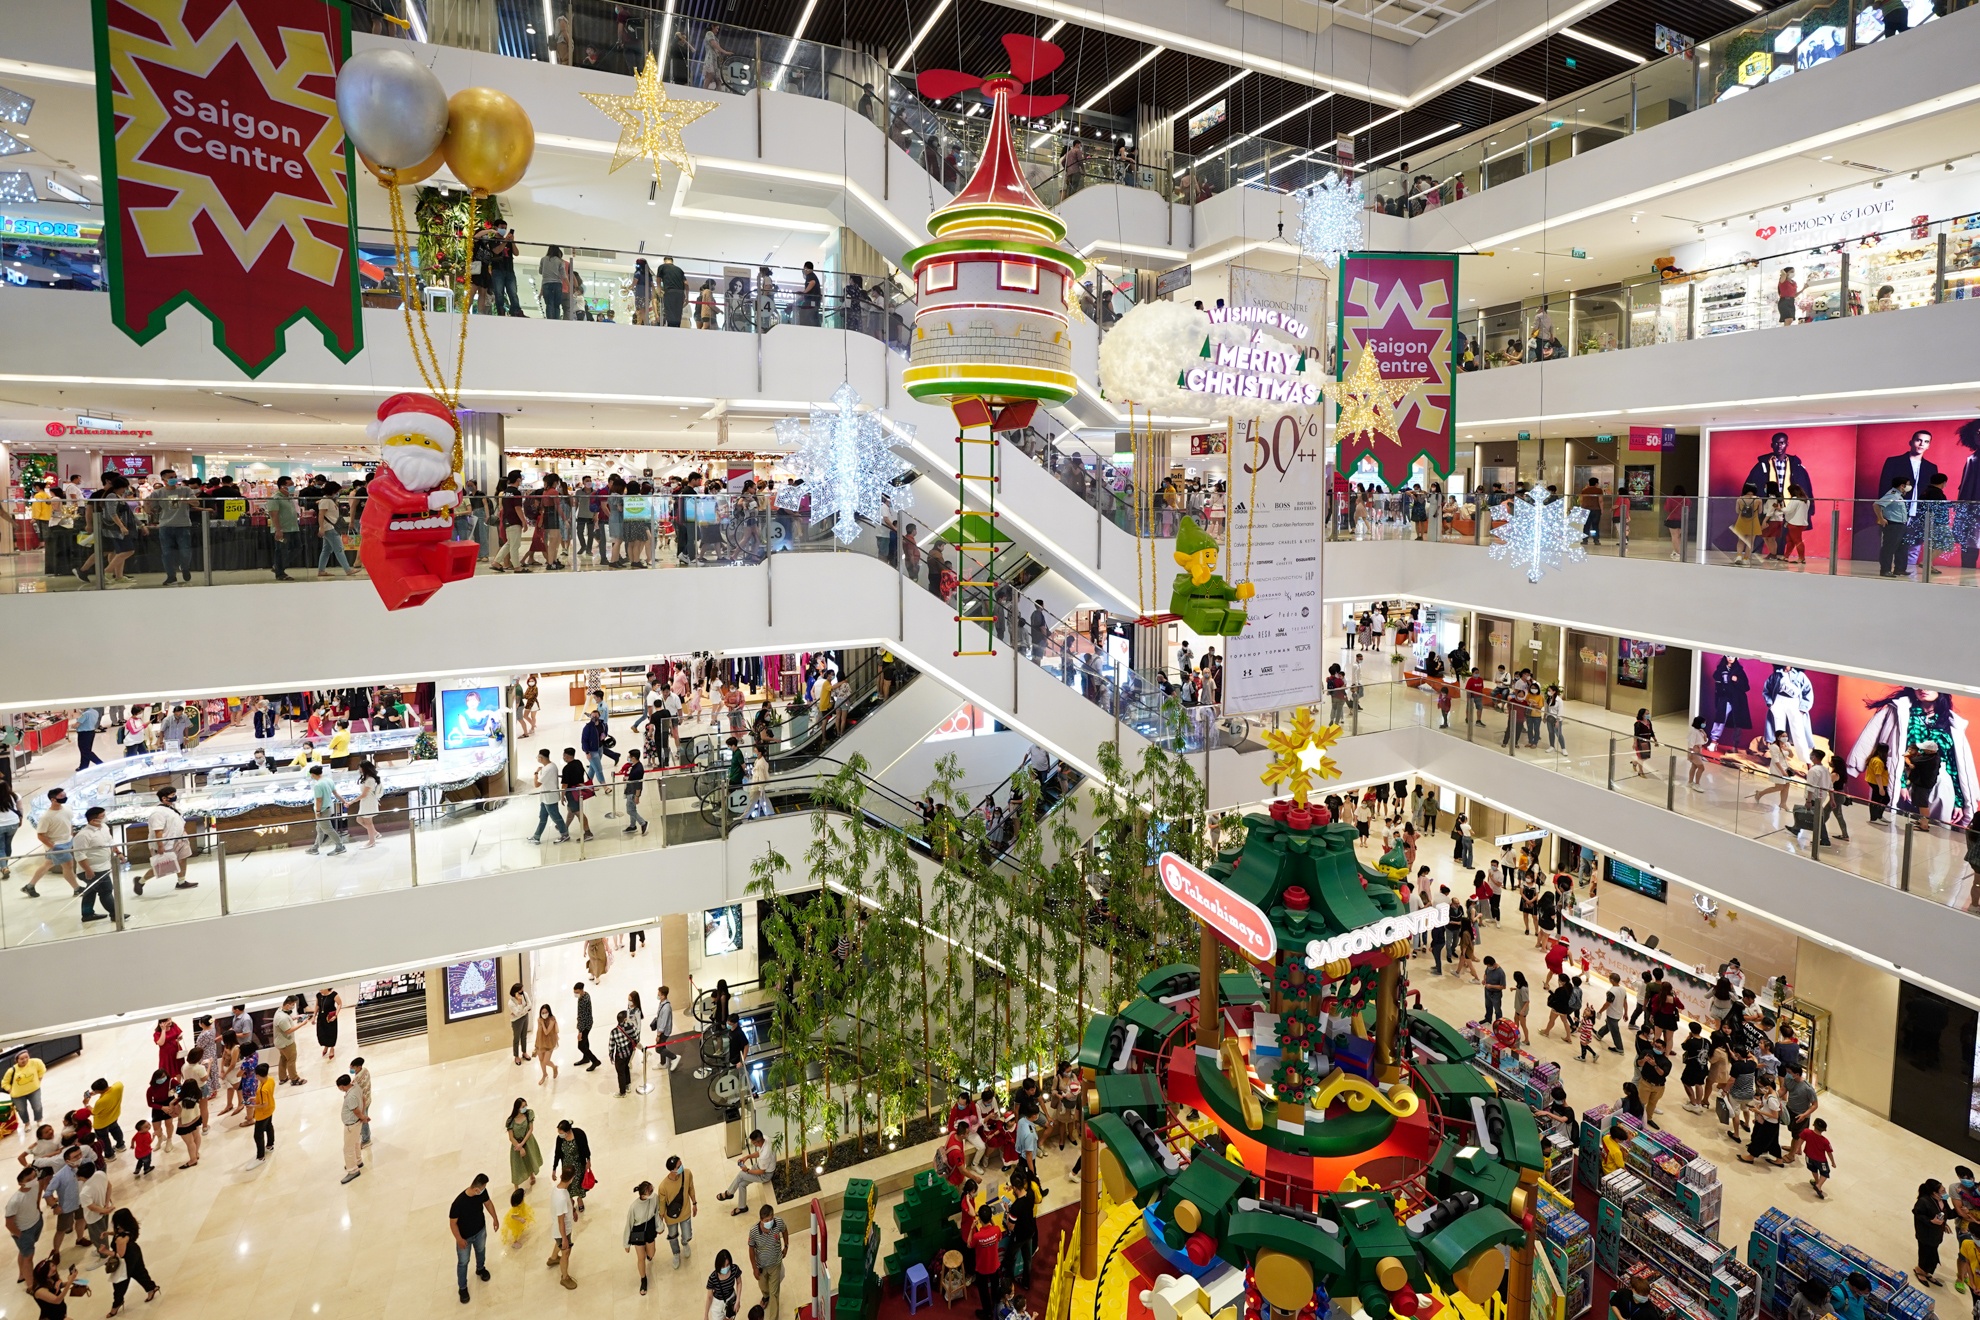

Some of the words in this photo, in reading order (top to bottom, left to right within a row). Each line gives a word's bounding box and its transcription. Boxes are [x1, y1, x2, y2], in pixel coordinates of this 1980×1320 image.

[730, 66, 747, 80] L5
[173, 89, 300, 148] Saigon
[173, 126, 303, 179] Centre
[1142, 172, 1154, 183] L5
[1779, 213, 1836, 236] MEMORY
[1840, 210, 1853, 222] &
[1857, 199, 1895, 218] LOVE
[14, 219, 79, 237] STORE
[1252, 298, 1309, 313] SAIGONCENTRE
[1208, 306, 1278, 324] WISHING
[1278, 312, 1309, 339] YOU
[1251, 328, 1264, 344] A
[1369, 337, 1428, 357] Saigon
[1215, 342, 1298, 376] MERRY
[1376, 359, 1428, 373] entre
[1186, 367, 1318, 405] CHRISTMAS
[1237, 422, 1246, 430] TO
[1230, 651, 1261, 659] TOPSHOP
[1230, 725, 1241, 735] L2
[730, 795, 747, 808] L2
[1181, 875, 1265, 947] Takashimaya
[1304, 902, 1451, 970] SAIGONCENTRE
[720, 1079, 735, 1093] L1
